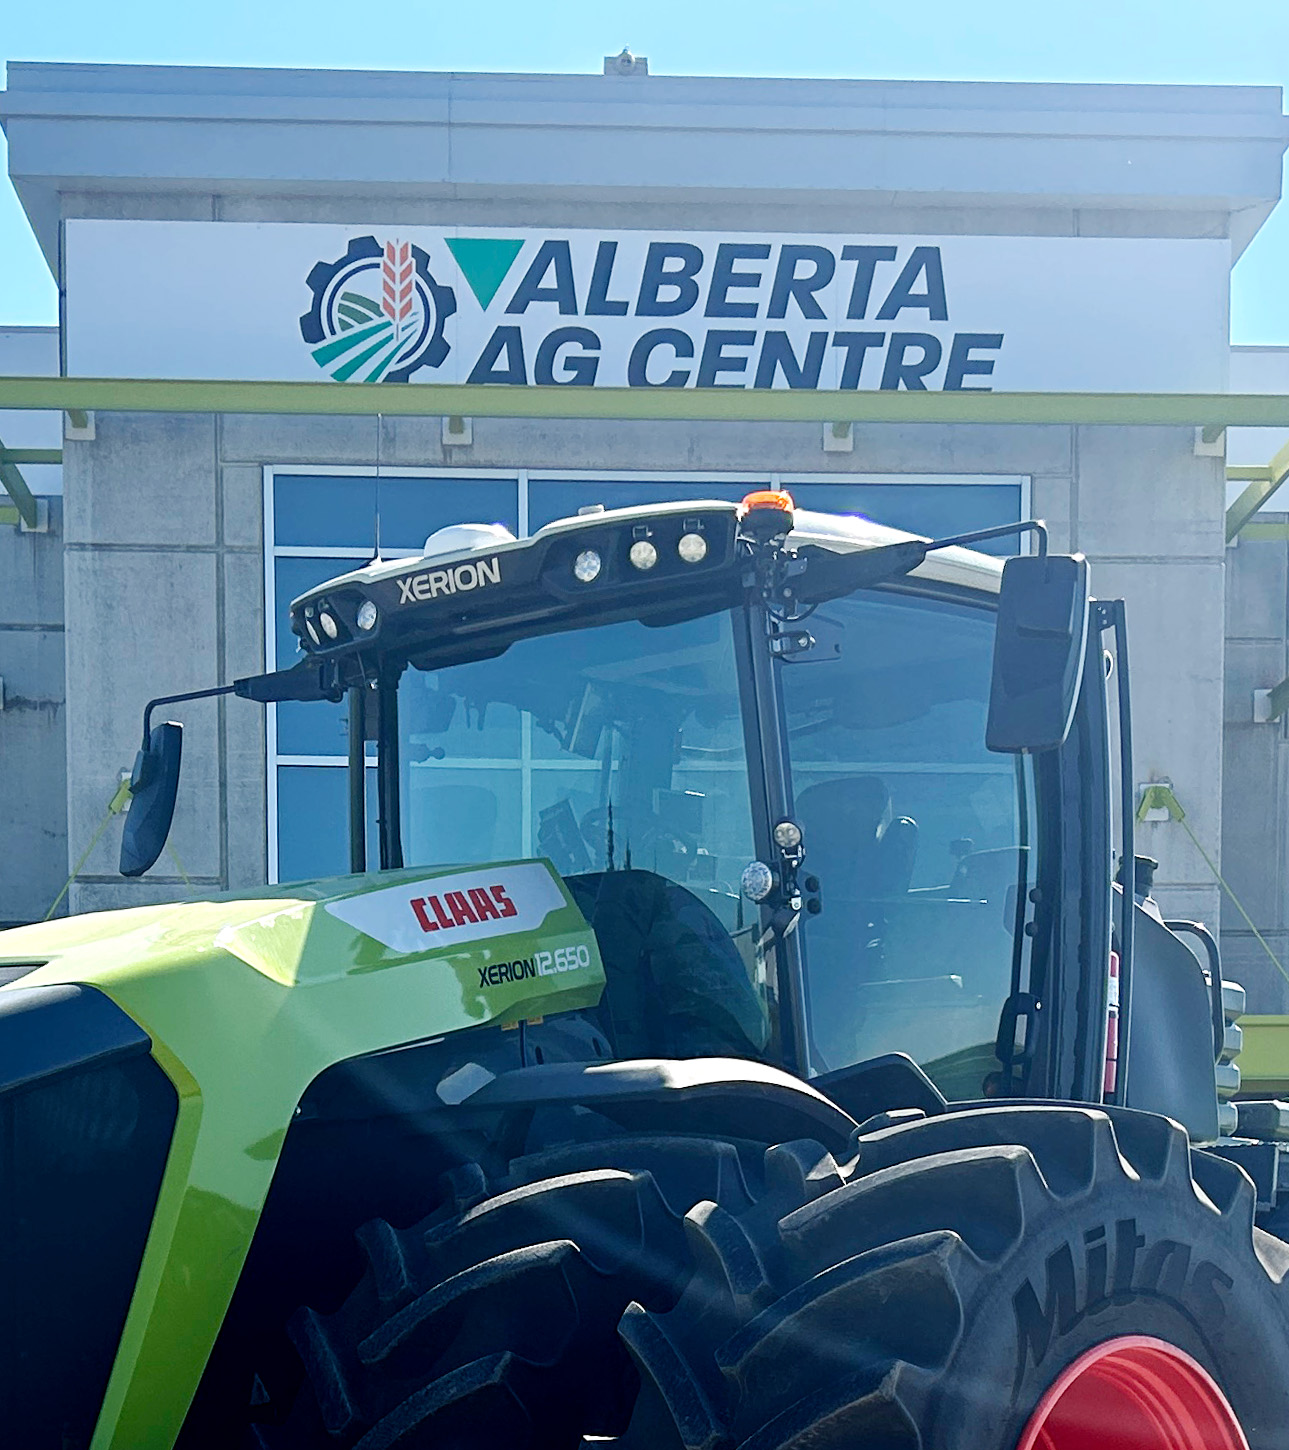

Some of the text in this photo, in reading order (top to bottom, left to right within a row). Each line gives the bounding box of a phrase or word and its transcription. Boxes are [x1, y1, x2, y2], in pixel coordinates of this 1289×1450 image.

[503, 239, 949, 322] ALBERTA
[466, 325, 1005, 391] AG CENTRE
[396, 557, 501, 605] XERION
[409, 885, 518, 933] CLAAS
[477, 957, 536, 989] XERION
[1011, 1217, 1236, 1378] Mitas
